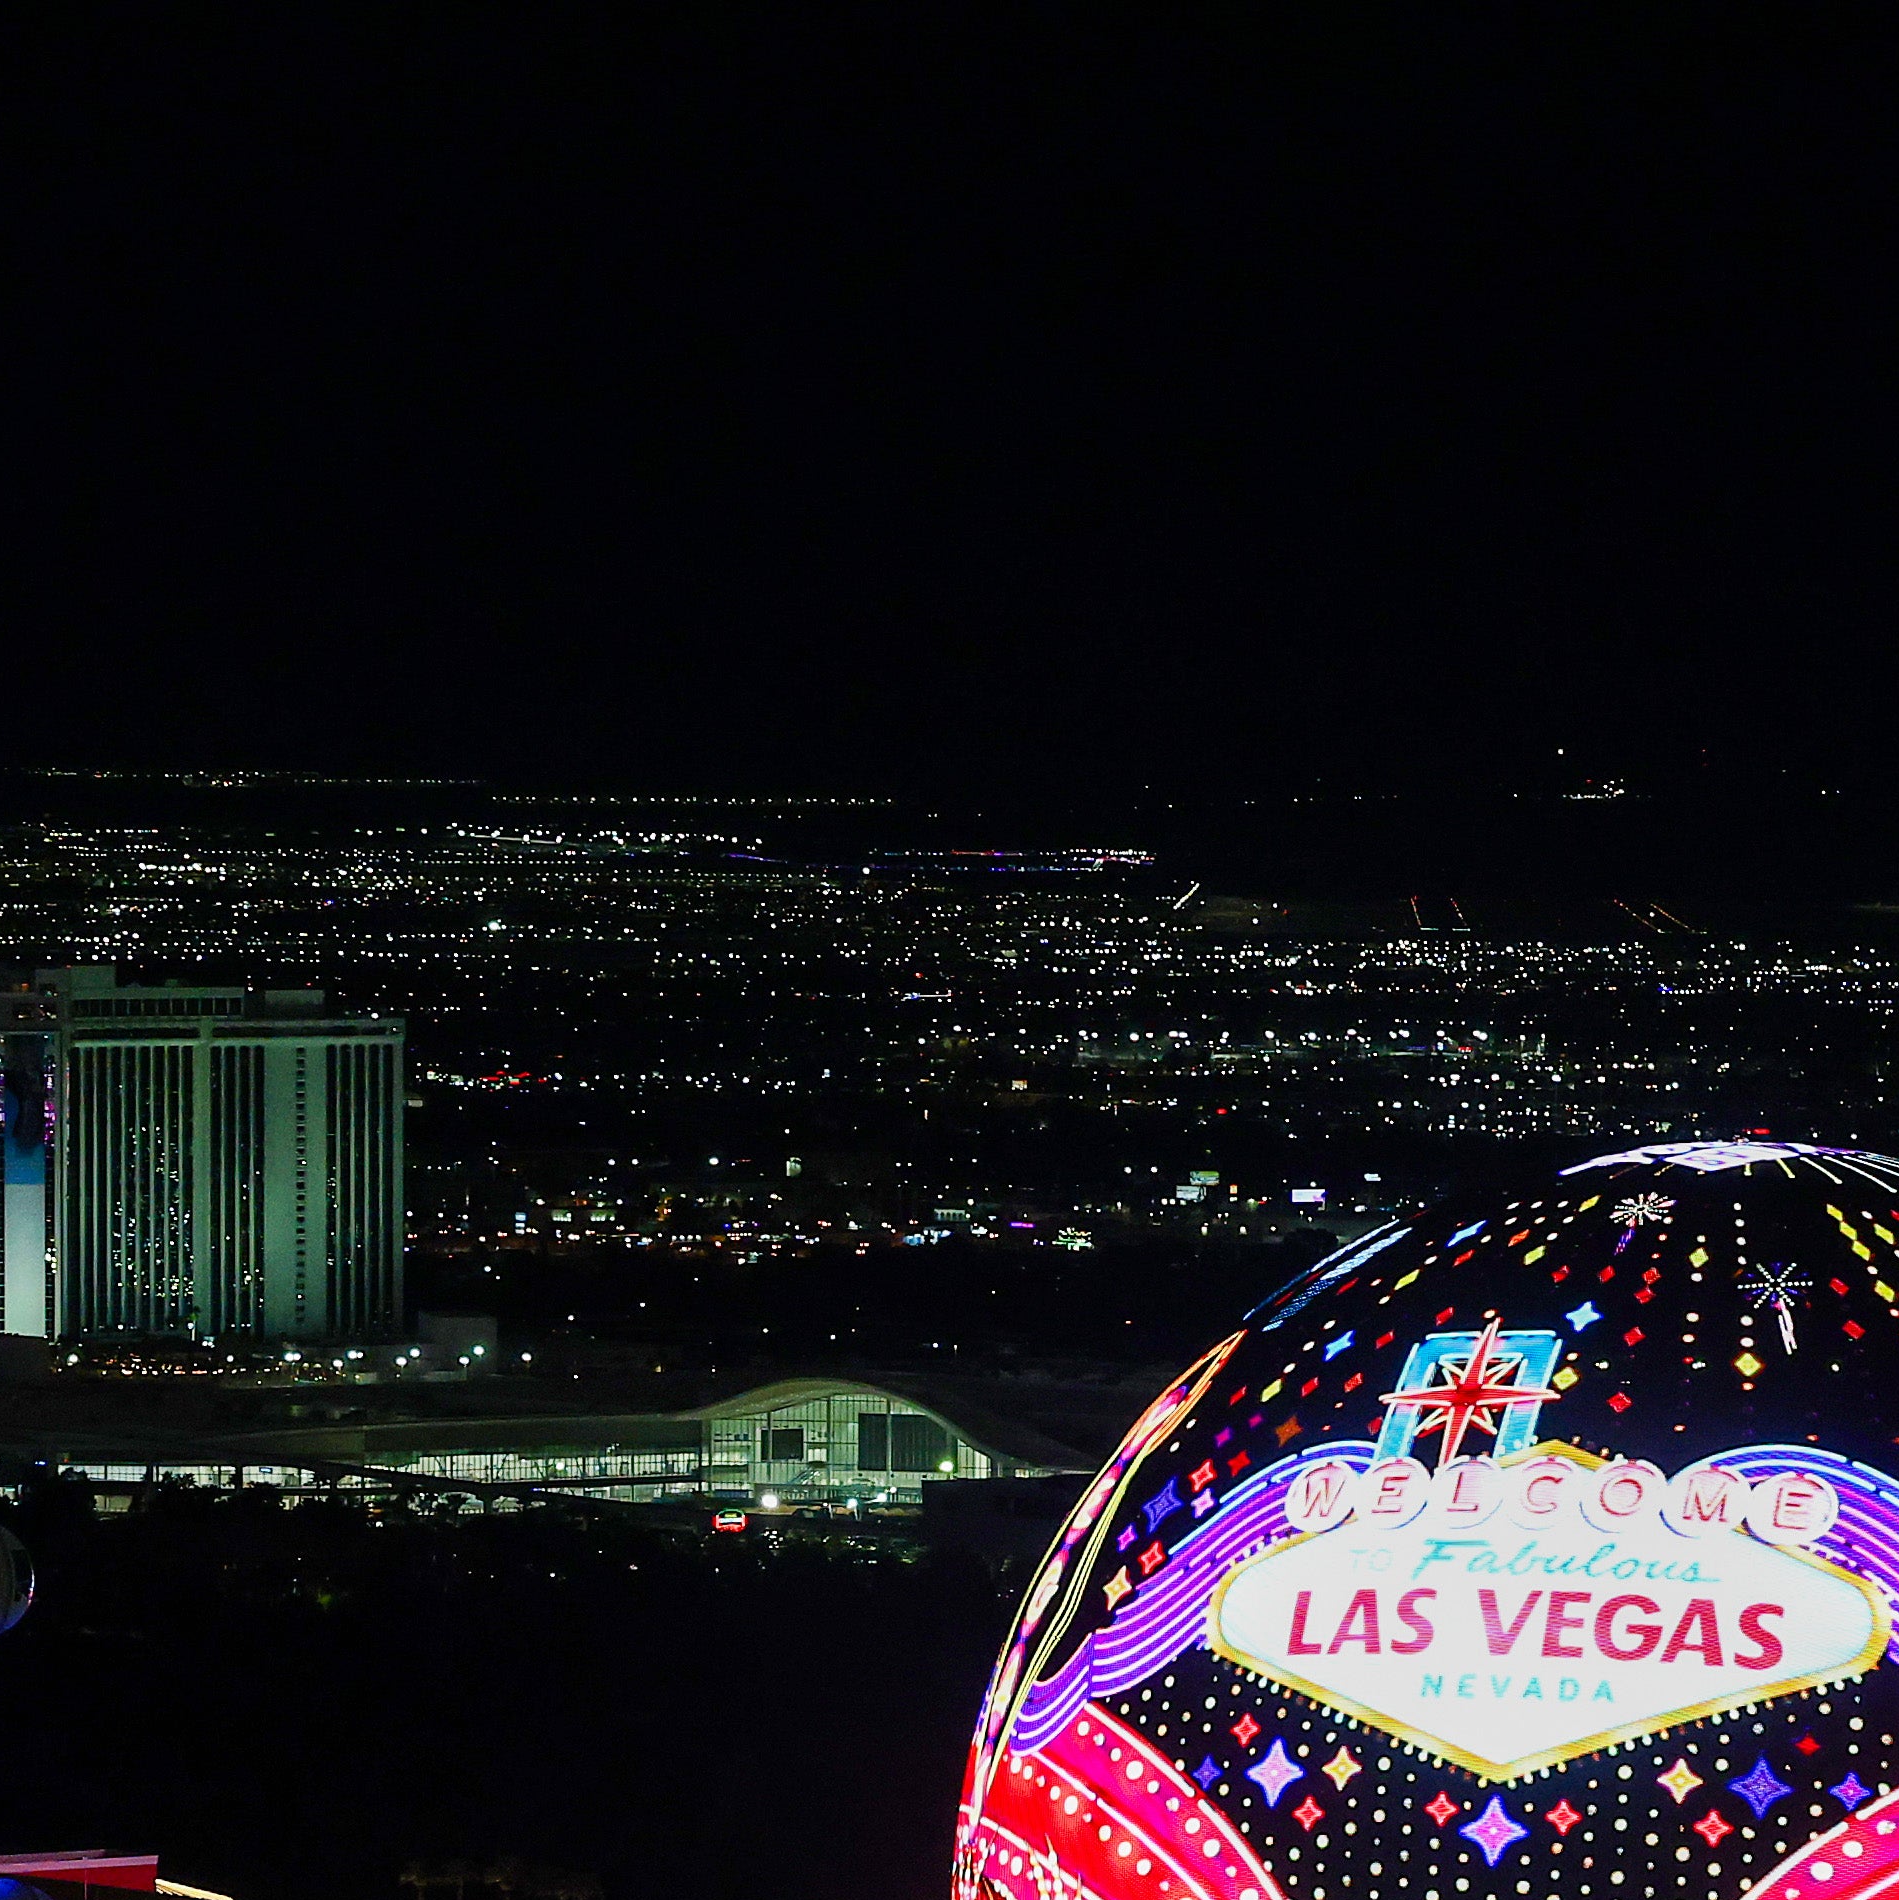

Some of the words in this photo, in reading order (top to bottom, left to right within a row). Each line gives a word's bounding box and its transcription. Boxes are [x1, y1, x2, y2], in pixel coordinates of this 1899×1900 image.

[1300, 1472, 1818, 1531] WELCOME
[1349, 1547, 1394, 1573] TO
[1410, 1538, 1721, 1585] Fabulous
[1286, 1588, 1438, 1656] LAS
[1477, 1588, 1785, 1670] VEGAS
[1420, 1673, 1615, 1703] NEVADA
